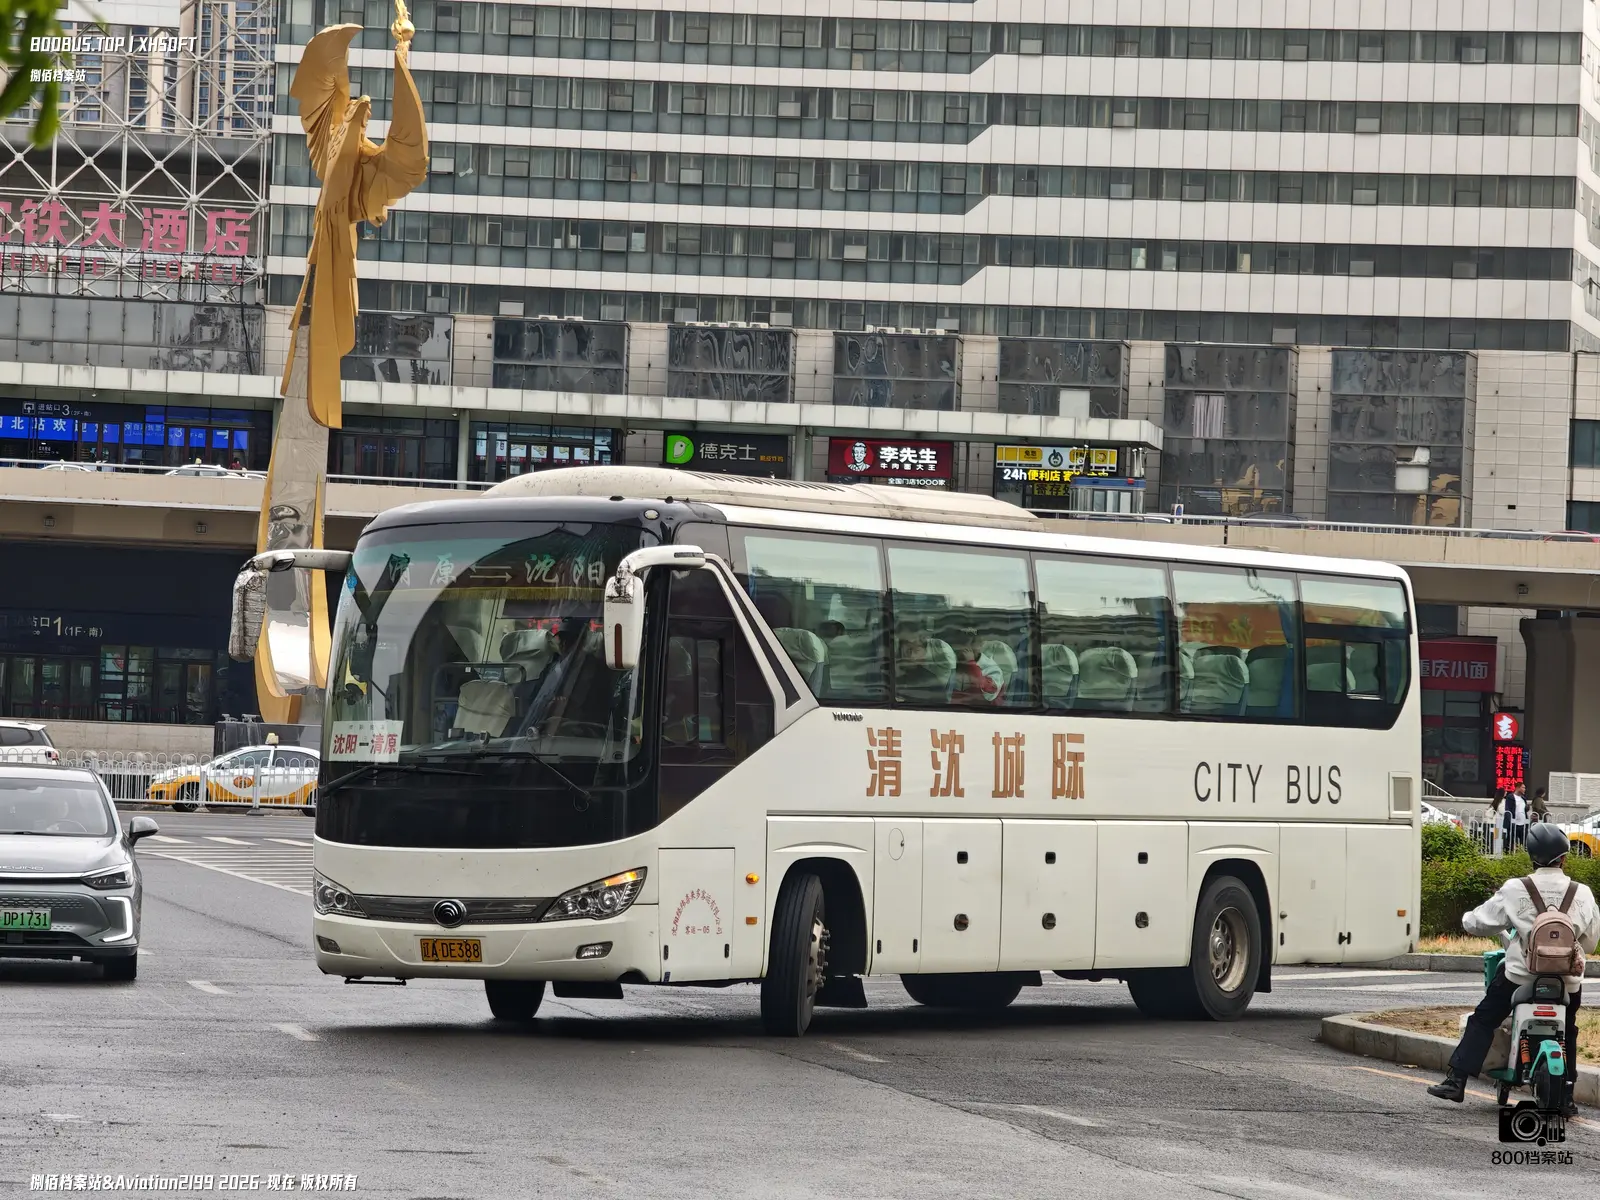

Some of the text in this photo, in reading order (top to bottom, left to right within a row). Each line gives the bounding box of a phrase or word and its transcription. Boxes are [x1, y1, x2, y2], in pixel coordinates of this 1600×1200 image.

[699, 442, 757, 461] 德克士
[879, 446, 938, 464] 李先生
[880, 463, 936, 471] 牛肉面大王
[866, 727, 1085, 800] 清沈城际
[1194, 761, 1342, 805] CITY BUS
